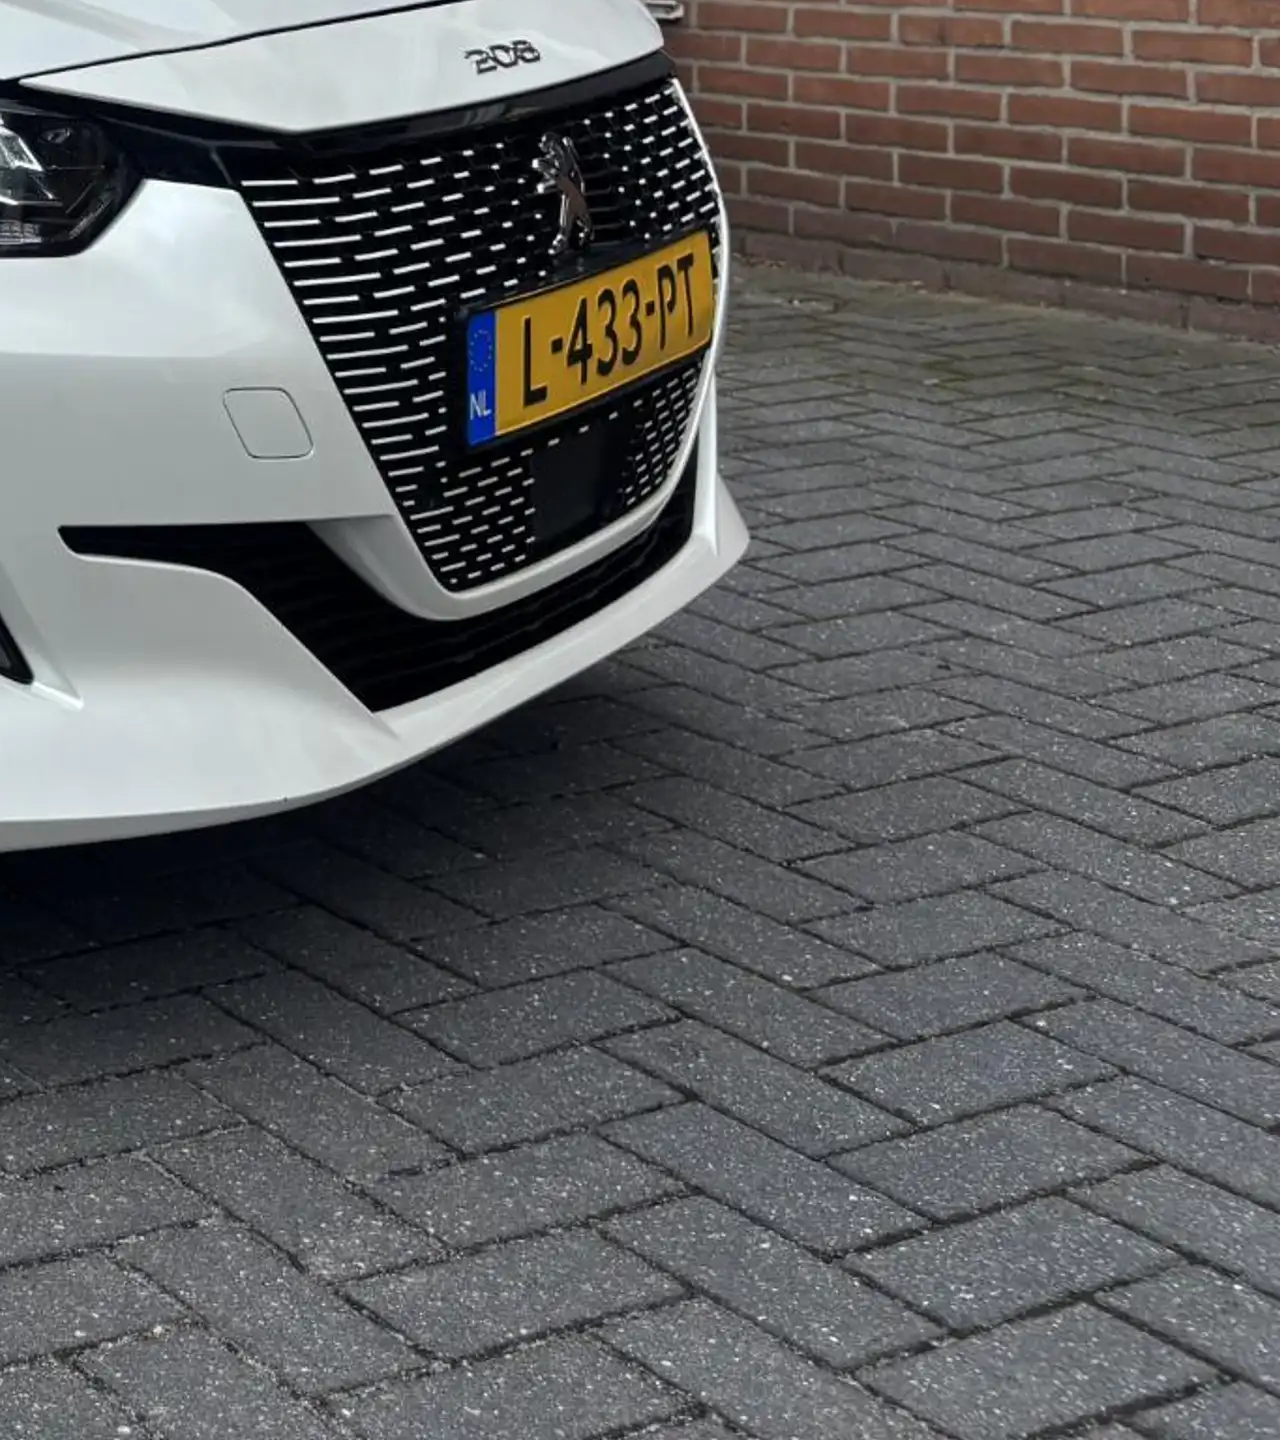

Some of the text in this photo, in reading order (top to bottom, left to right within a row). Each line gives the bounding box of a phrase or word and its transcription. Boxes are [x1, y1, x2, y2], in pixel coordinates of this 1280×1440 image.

[464, 40, 540, 75] 208
[521, 252, 696, 408] L-433-PT
[469, 389, 493, 421] NL
